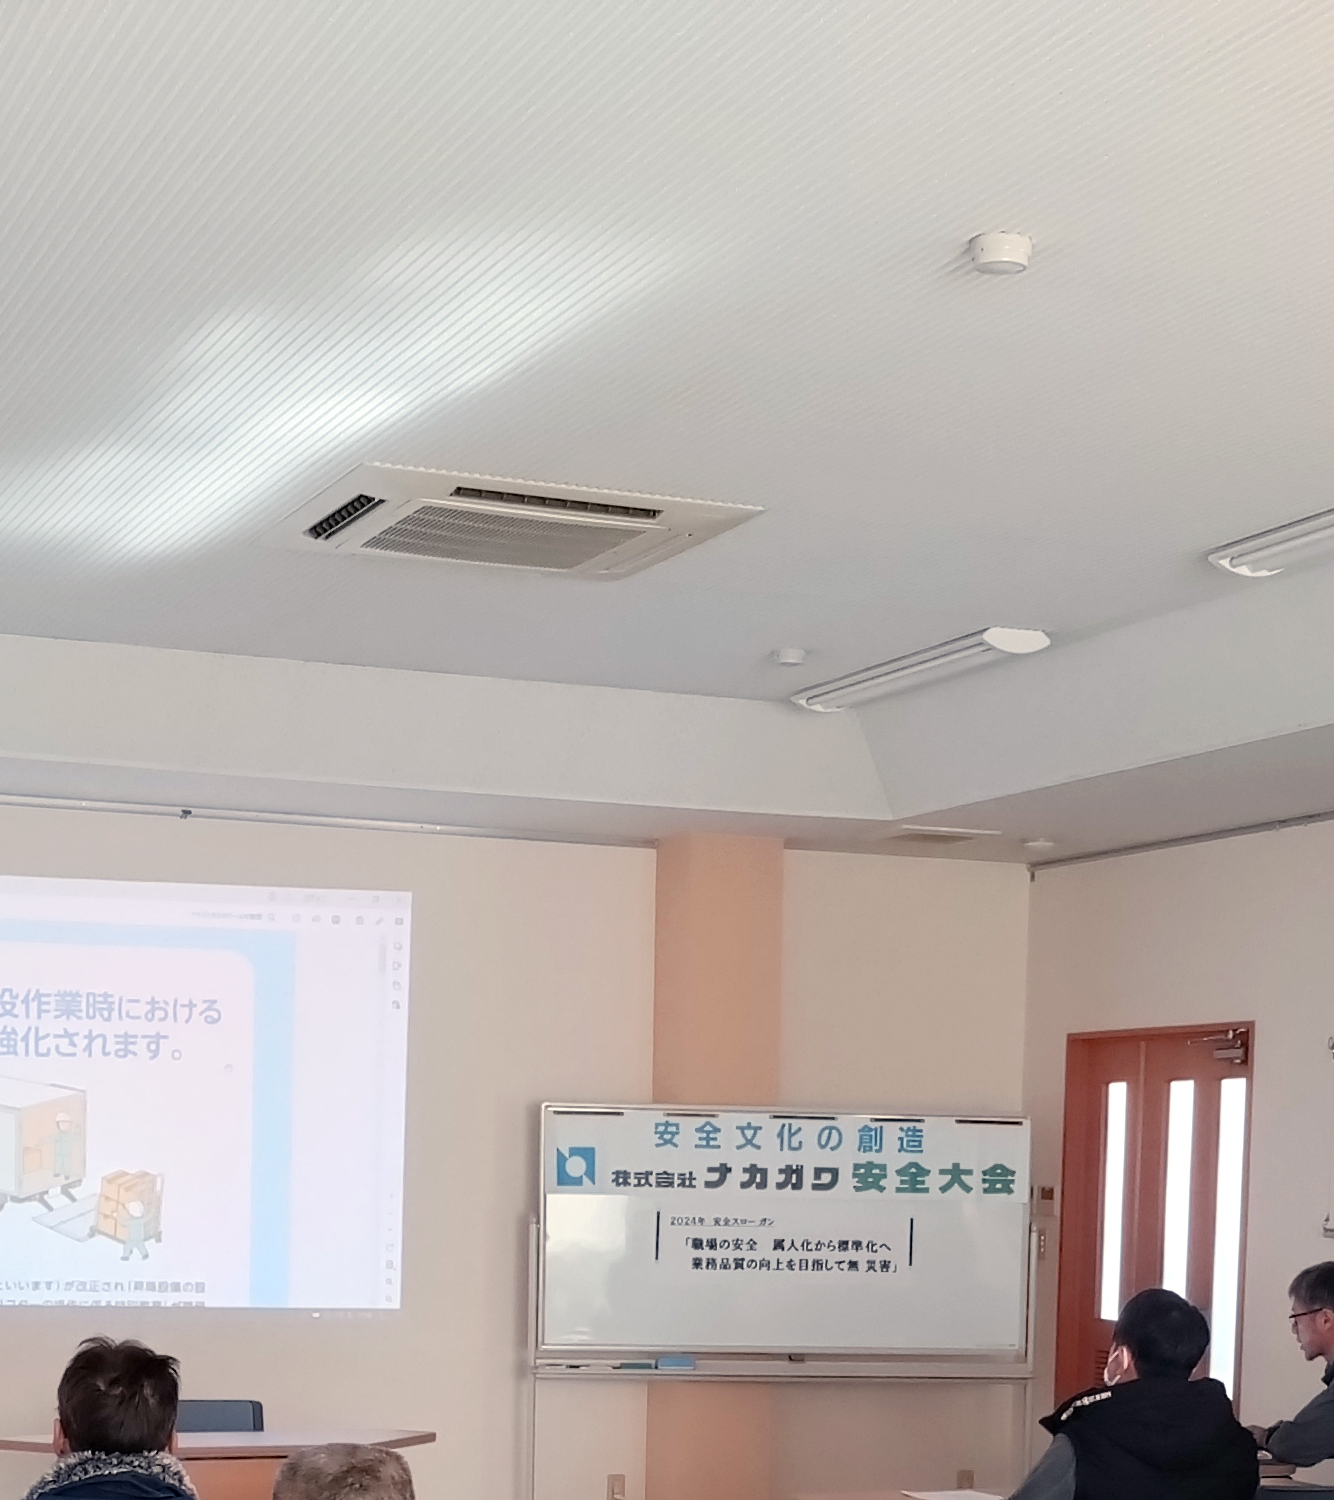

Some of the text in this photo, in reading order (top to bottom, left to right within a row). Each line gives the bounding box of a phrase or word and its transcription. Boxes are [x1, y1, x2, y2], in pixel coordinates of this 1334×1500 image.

[654, 1120, 926, 1155] 安全文化の創造
[610, 1161, 1018, 1196] 株式会社 ナカガワ 安全大会
[670, 1216, 706, 1227] 2024年
